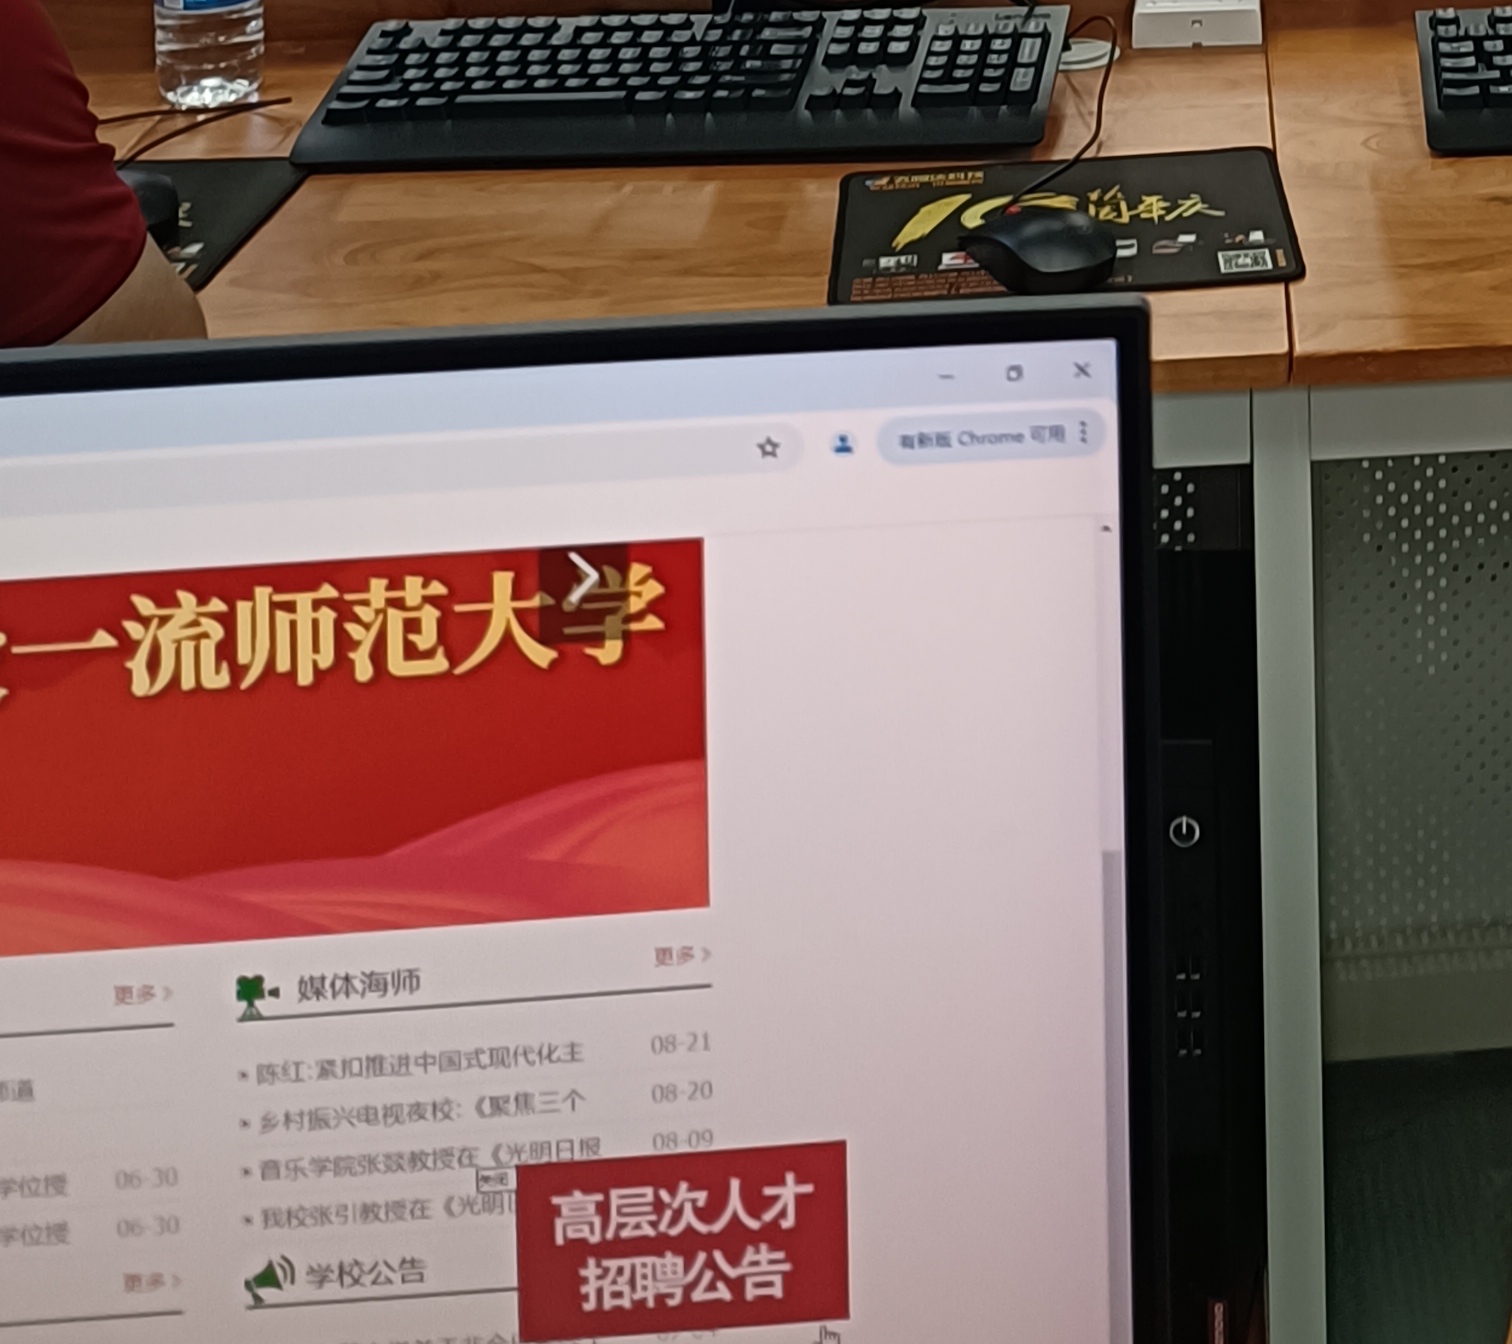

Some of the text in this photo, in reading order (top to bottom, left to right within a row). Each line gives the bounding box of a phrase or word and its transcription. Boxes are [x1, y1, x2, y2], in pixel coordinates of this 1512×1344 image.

[958, 429, 1025, 447] Chrome
[0, 562, 666, 699] 一流师范大学
[653, 946, 697, 969] 更多
[113, 983, 157, 1006] 更多
[298, 967, 422, 1004] 媒体海师
[651, 1032, 713, 1056] 08-21
[652, 1080, 714, 1104] 08-20
[653, 1128, 714, 1153] 08-09
[115, 1167, 179, 1191] 06-30
[261, 1192, 515, 1231] 我校张引教授在《光明
[550, 1171, 815, 1246] 高层次人才
[116, 1215, 181, 1239] 06-30
[306, 1258, 428, 1290] 学校公告
[579, 1244, 791, 1312] 招聘公告
